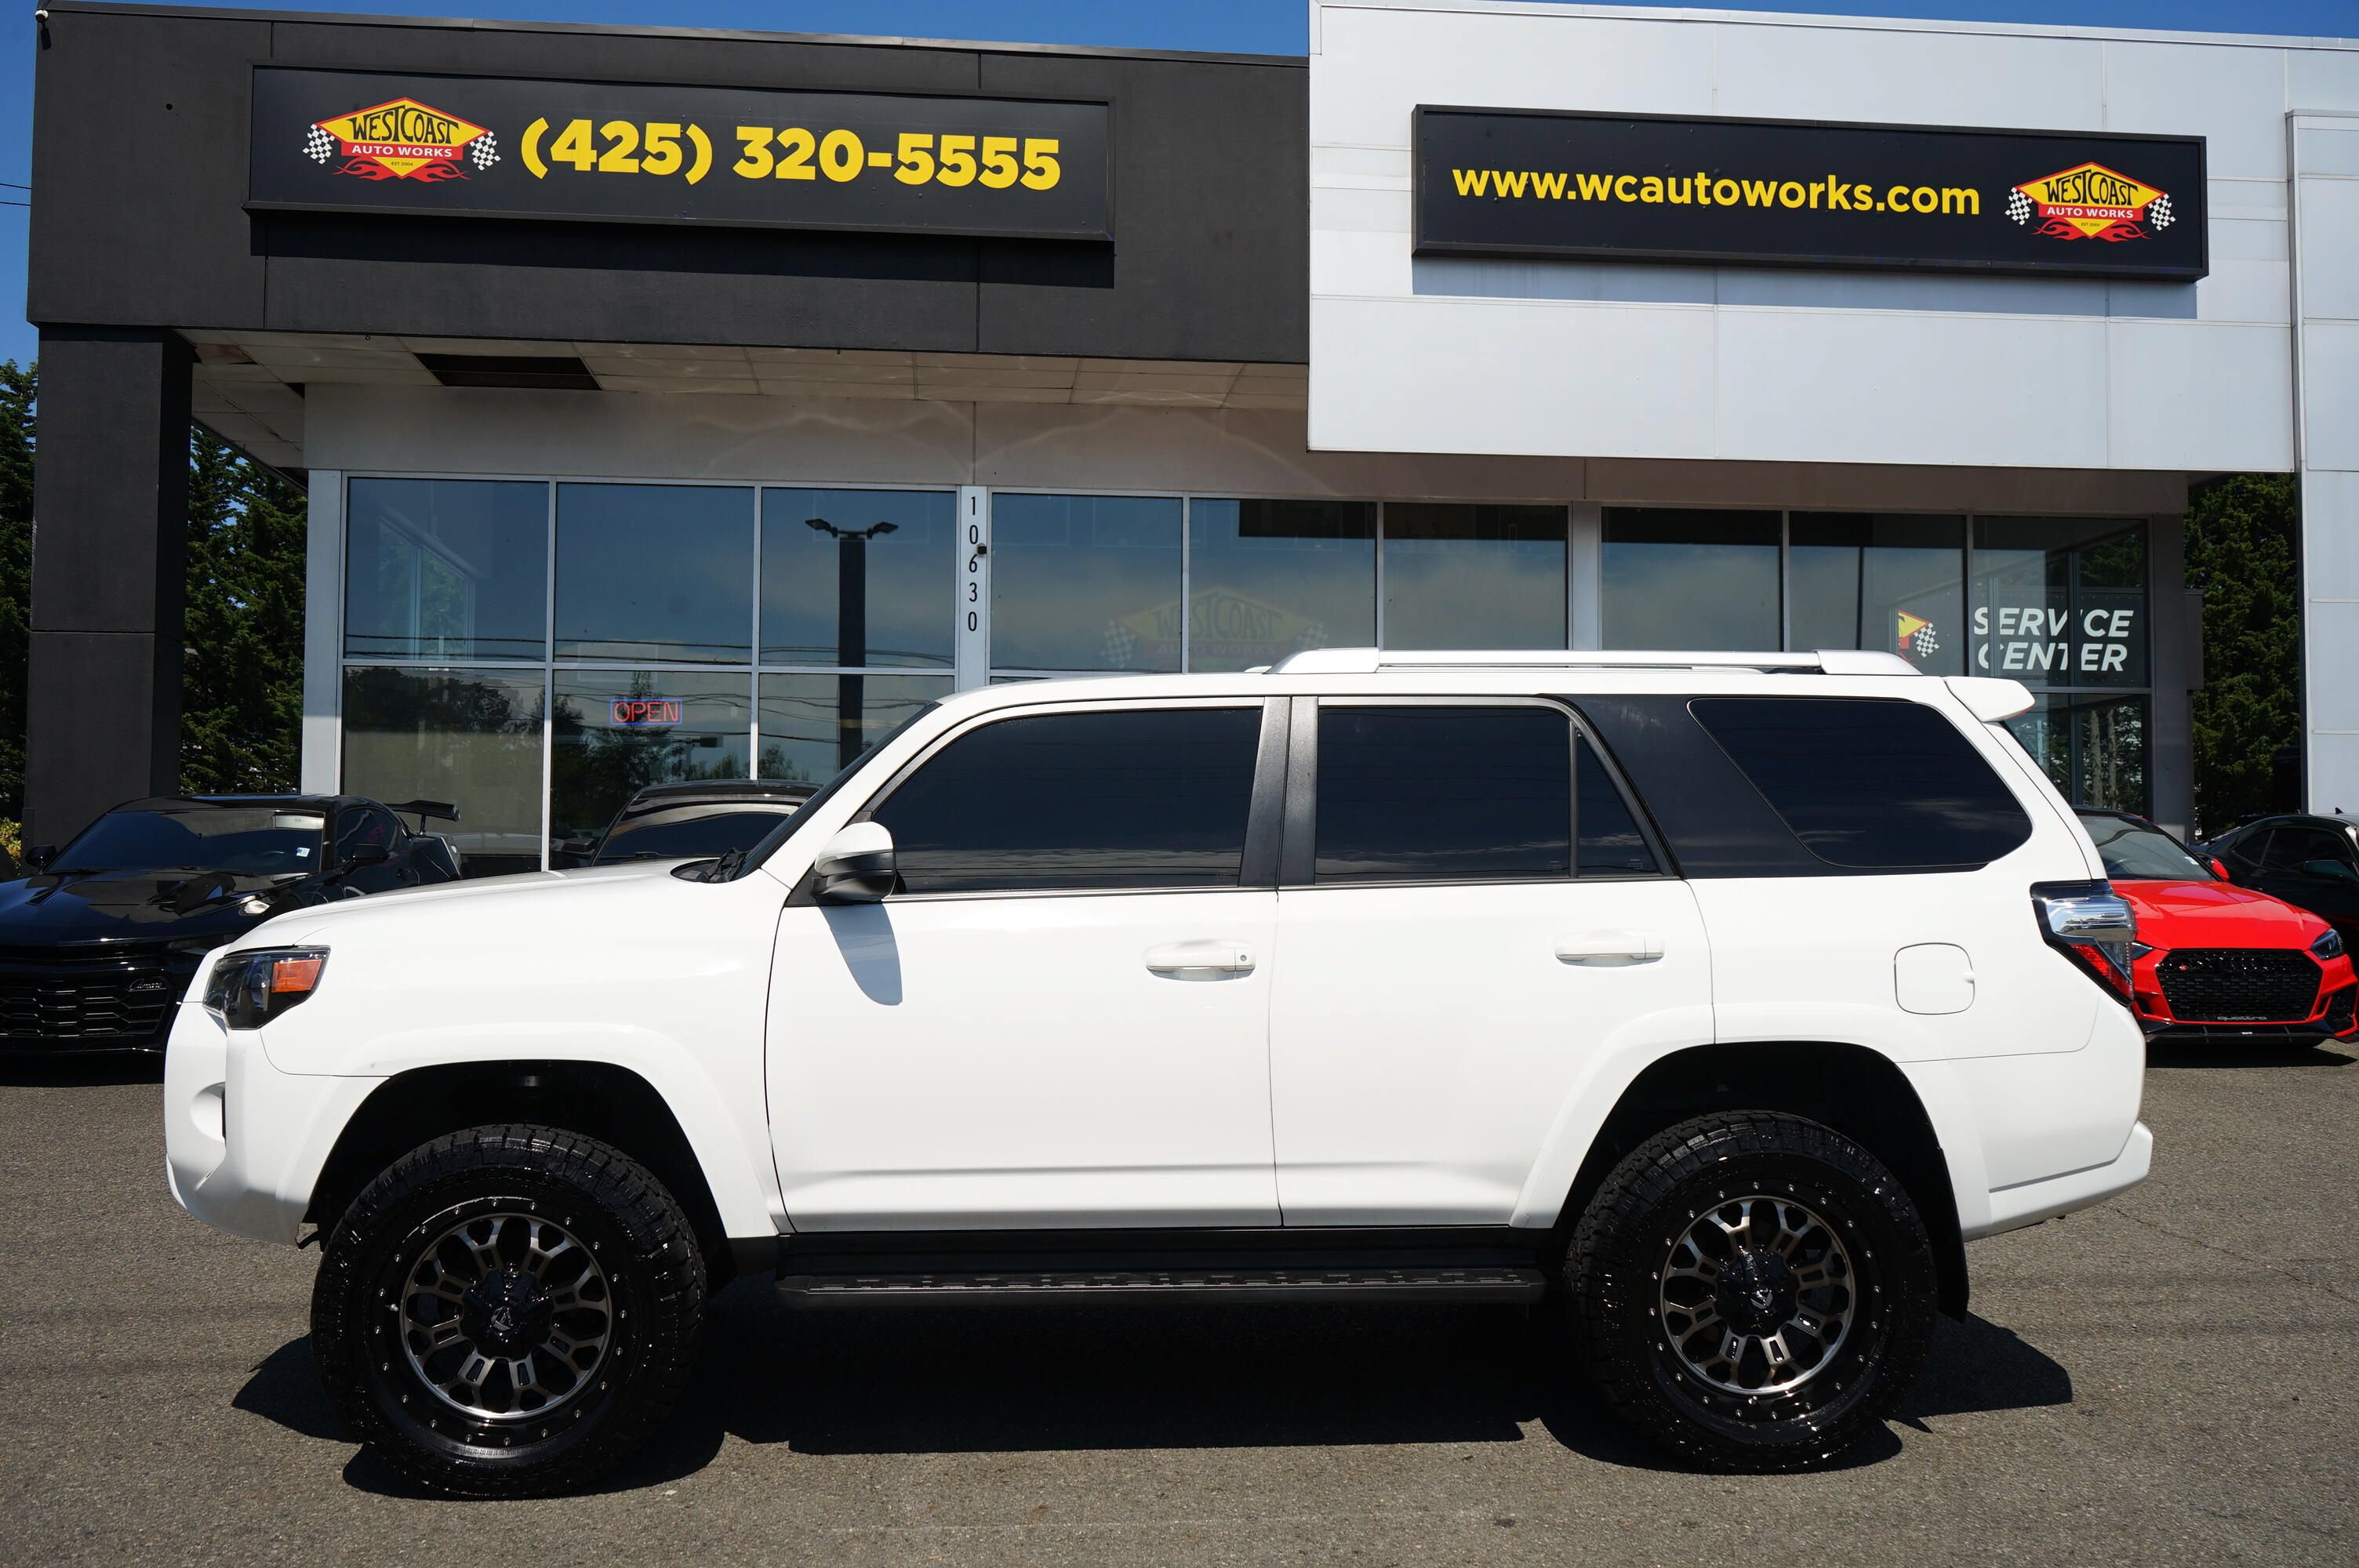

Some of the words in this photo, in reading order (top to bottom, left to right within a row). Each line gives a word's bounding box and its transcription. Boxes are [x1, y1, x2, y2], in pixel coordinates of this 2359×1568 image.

[352, 146, 393, 155] AUTO
[398, 147, 453, 158] WORKS
[522, 118, 713, 186] (425)
[732, 125, 1061, 191] 320-5555
[1452, 169, 1979, 215] www.wcautoworks.com
[2048, 206, 2083, 216] AUTO
[2086, 209, 2134, 219] WORKS
[969, 496, 979, 632] 10630
[1974, 607, 2134, 637] SERVCE
[1211, 644, 1275, 655] WORKS
[614, 702, 678, 722] OPEN
